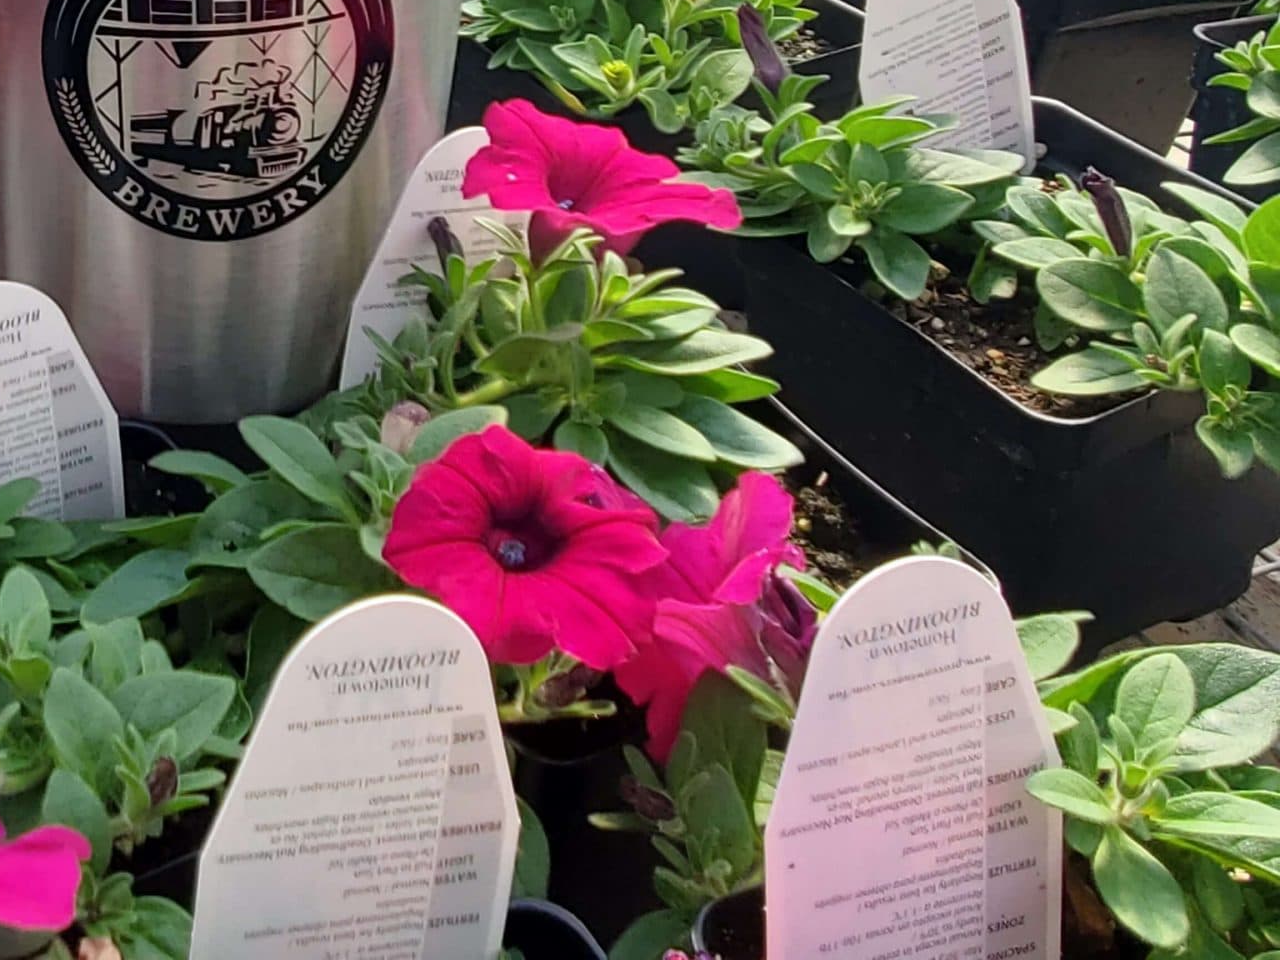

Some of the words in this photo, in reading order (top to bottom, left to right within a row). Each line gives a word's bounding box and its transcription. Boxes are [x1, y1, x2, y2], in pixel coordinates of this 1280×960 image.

[112, 167, 330, 234] BREWERY
[868, 625, 956, 665] Hometown
[336, 670, 430, 699] Hometown
[984, 674, 1016, 695] CARE
[985, 707, 1015, 727] USES
[451, 728, 485, 744] CARE
[448, 761, 480, 778] USES
[987, 798, 1021, 817] LIGHT
[439, 819, 501, 839] FEATURES
[986, 814, 1028, 836] WATER
[950, 826, 983, 846] Normal
[435, 853, 474, 869] LIGHT
[987, 855, 1036, 879] FERTILIZE
[433, 868, 477, 886] WATER
[986, 913, 1025, 934] ZONES
[986, 940, 1036, 960] SPACING
